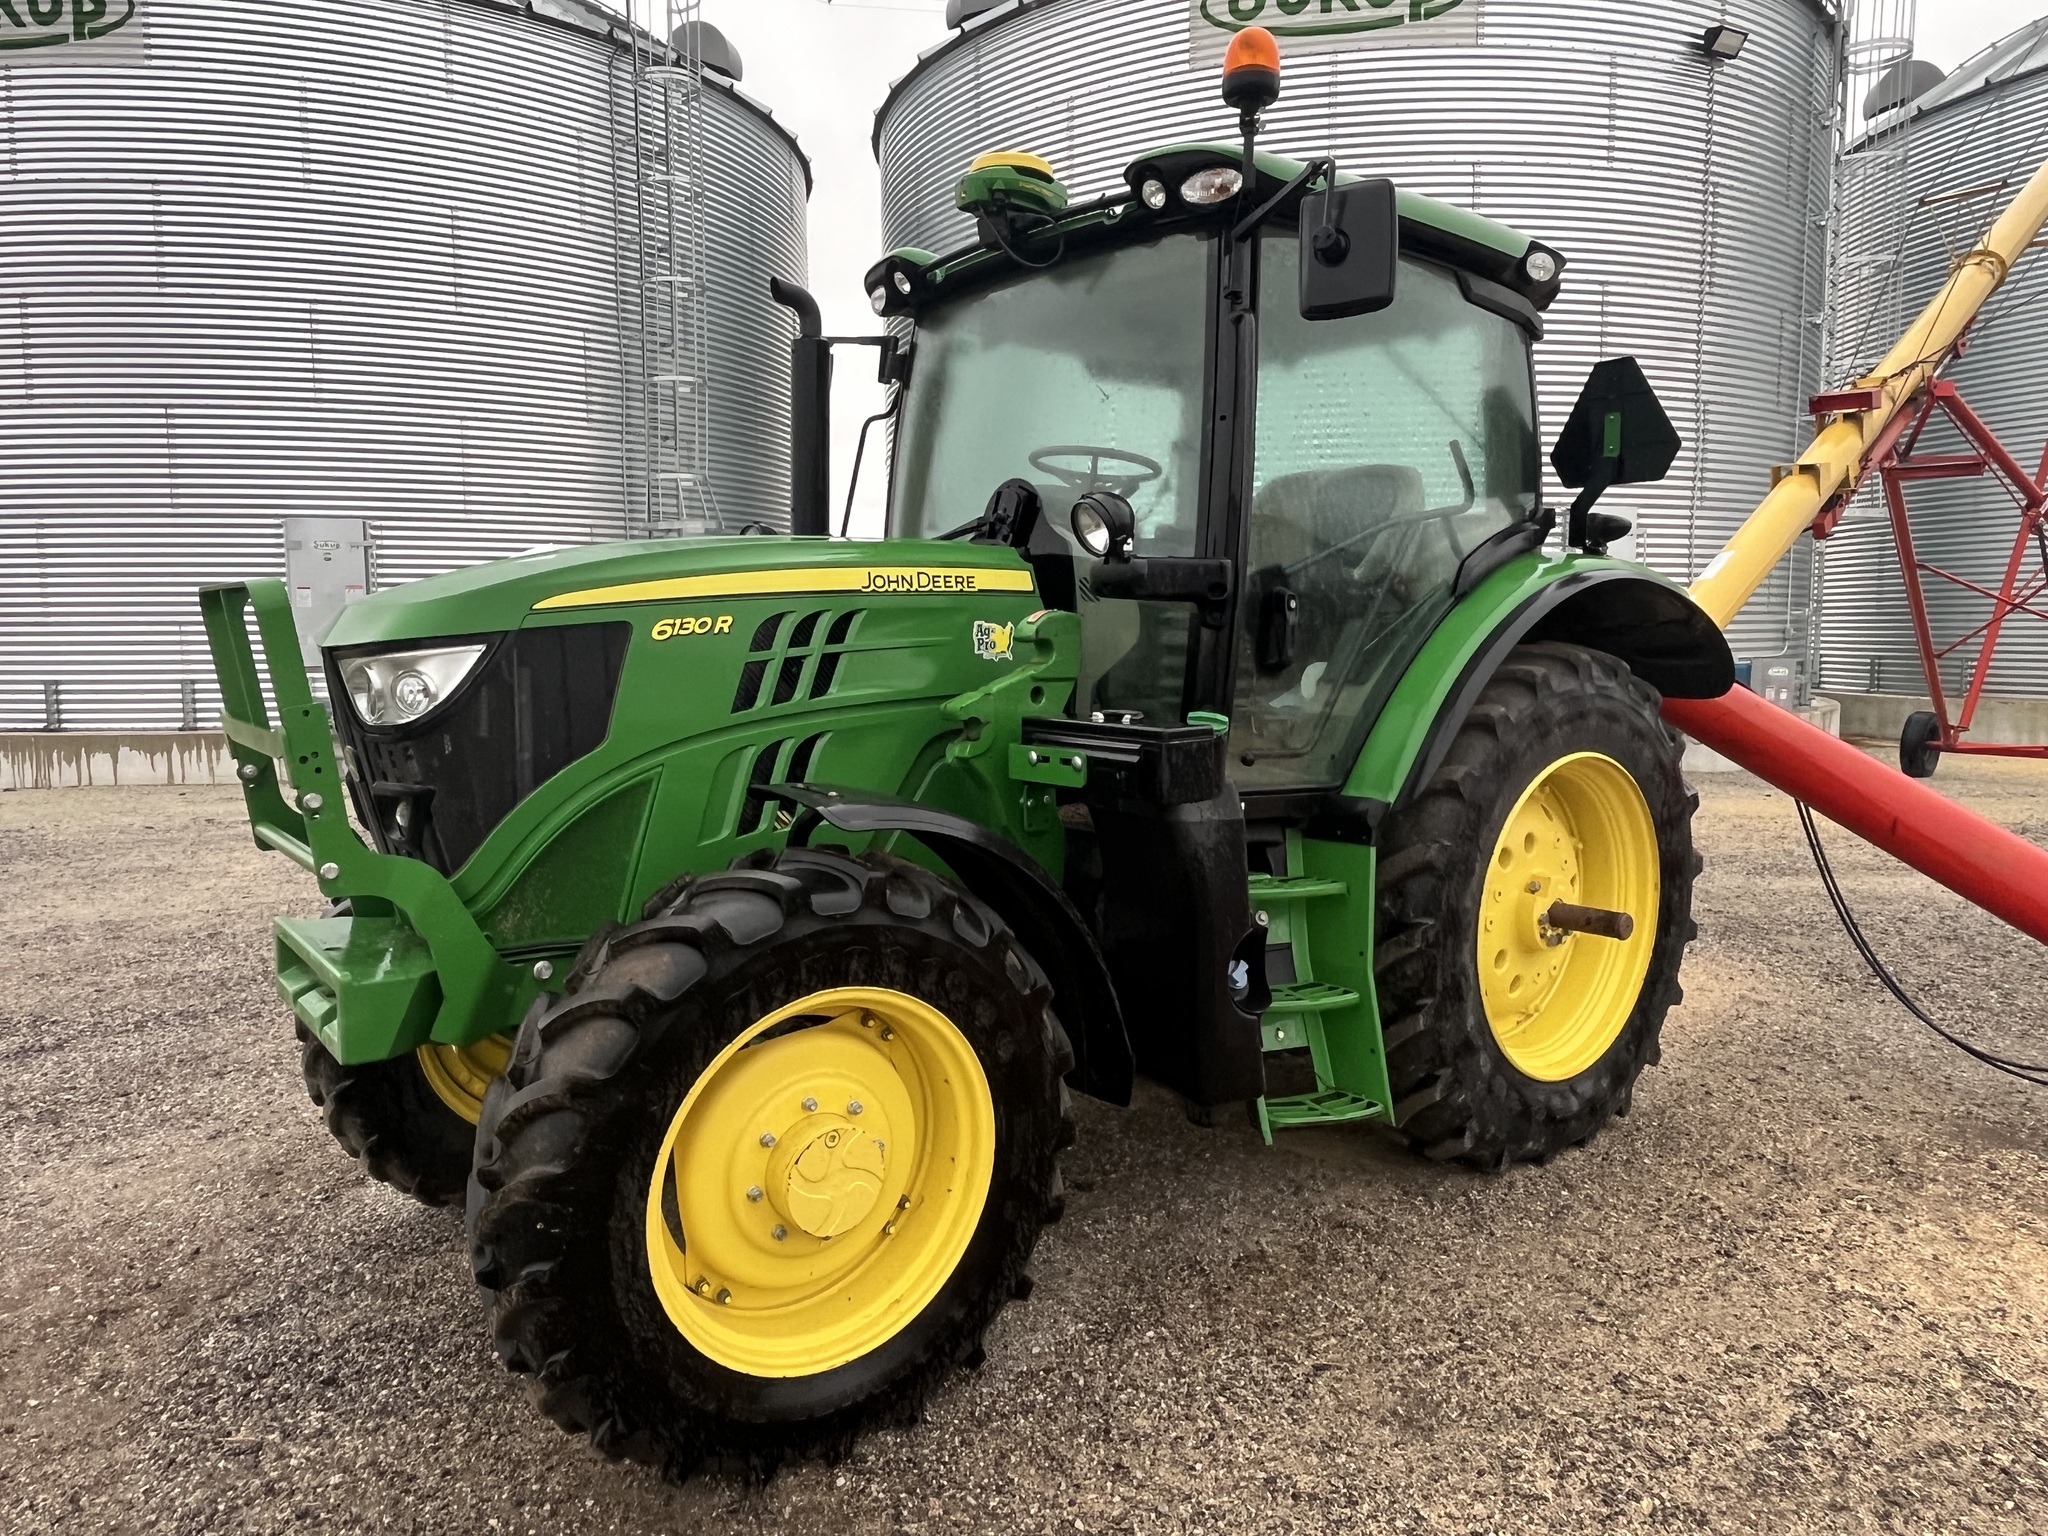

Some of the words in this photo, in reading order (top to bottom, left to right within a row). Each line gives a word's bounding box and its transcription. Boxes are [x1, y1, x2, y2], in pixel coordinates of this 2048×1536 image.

[861, 571, 913, 590] JOHN
[916, 571, 976, 589] DEERE
[976, 637, 997, 652] Pro
